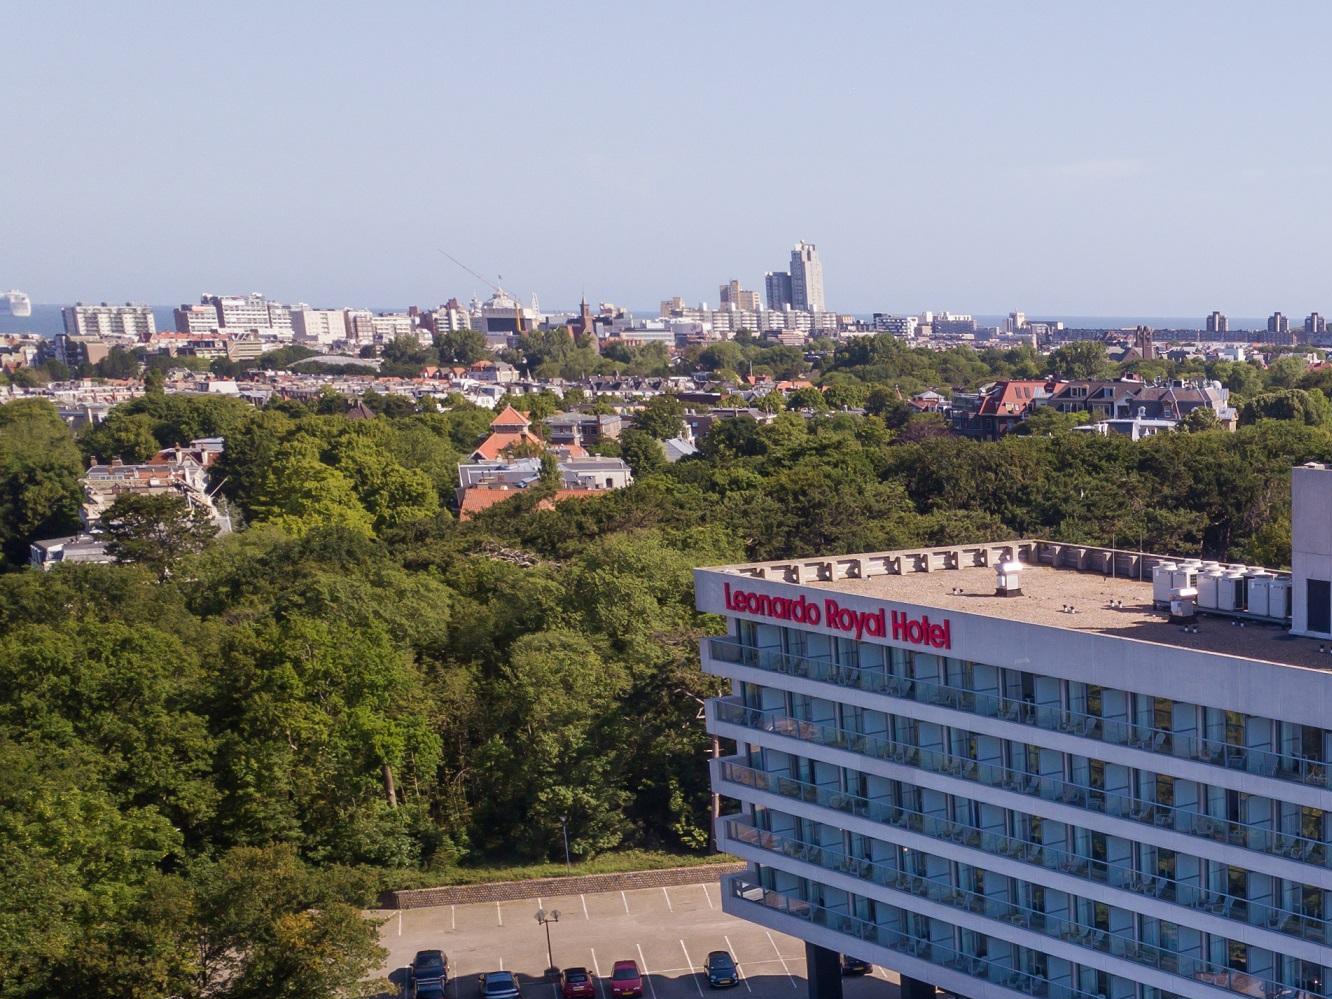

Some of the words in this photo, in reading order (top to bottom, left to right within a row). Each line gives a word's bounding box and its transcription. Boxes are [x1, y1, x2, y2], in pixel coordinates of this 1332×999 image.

[724, 582, 821, 626] Leonardo
[824, 598, 887, 640] Royal
[891, 610, 951, 650] Hotel
